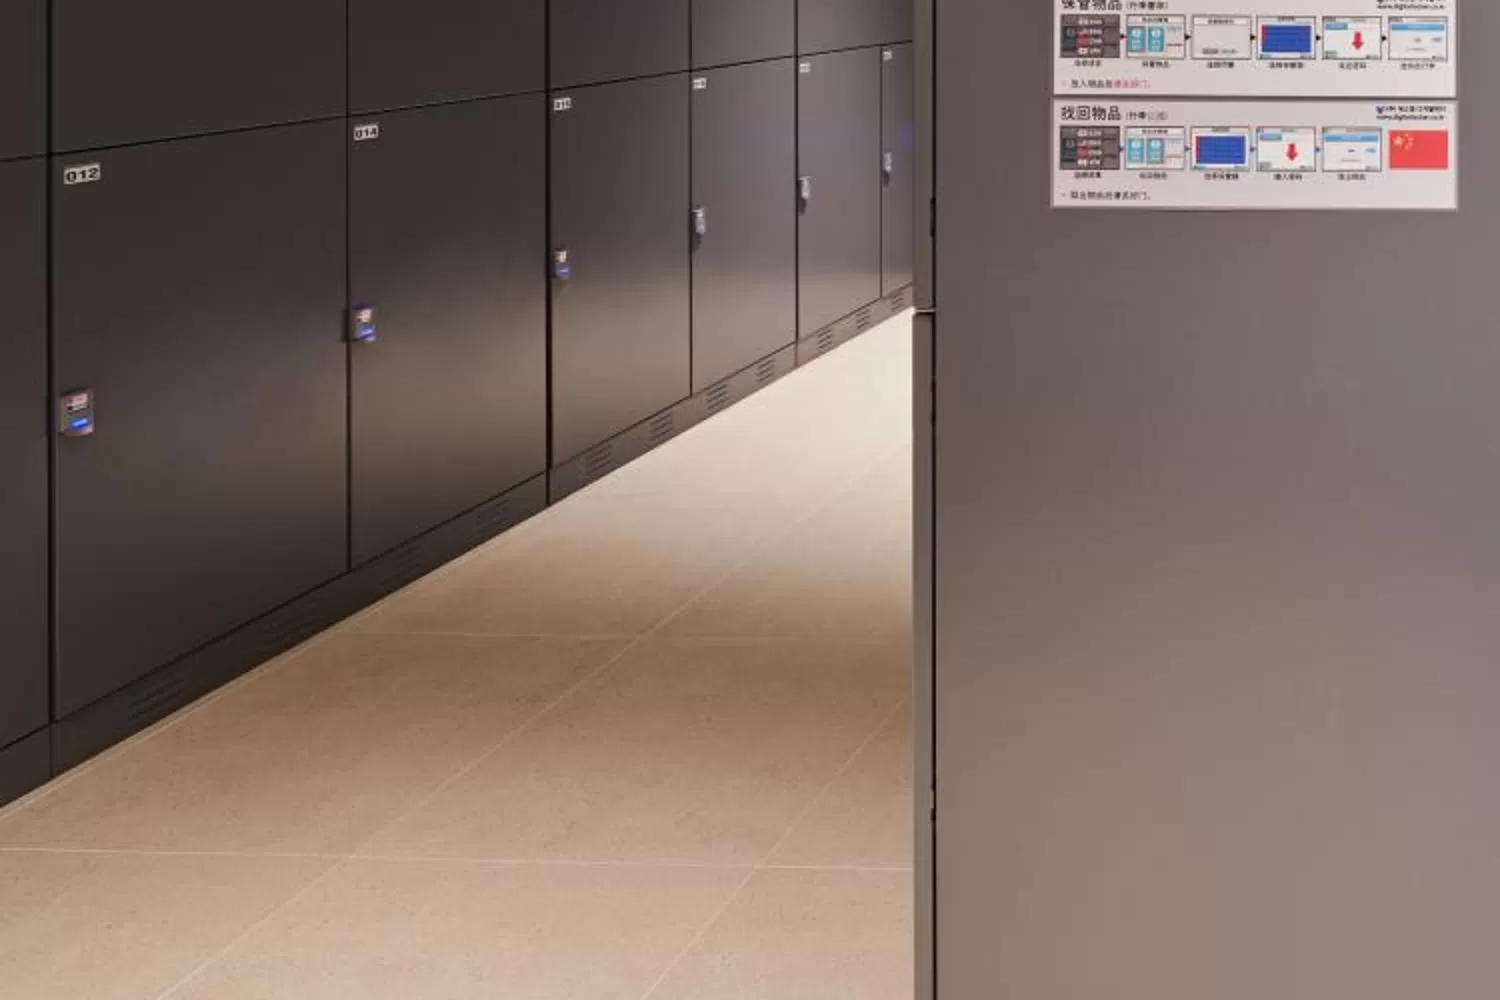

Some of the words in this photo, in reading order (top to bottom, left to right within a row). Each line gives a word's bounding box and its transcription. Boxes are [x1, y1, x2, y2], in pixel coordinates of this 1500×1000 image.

[1061, 105, 1121, 121] 找回物品
[354, 126, 379, 139] 014
[65, 165, 99, 183] 012
